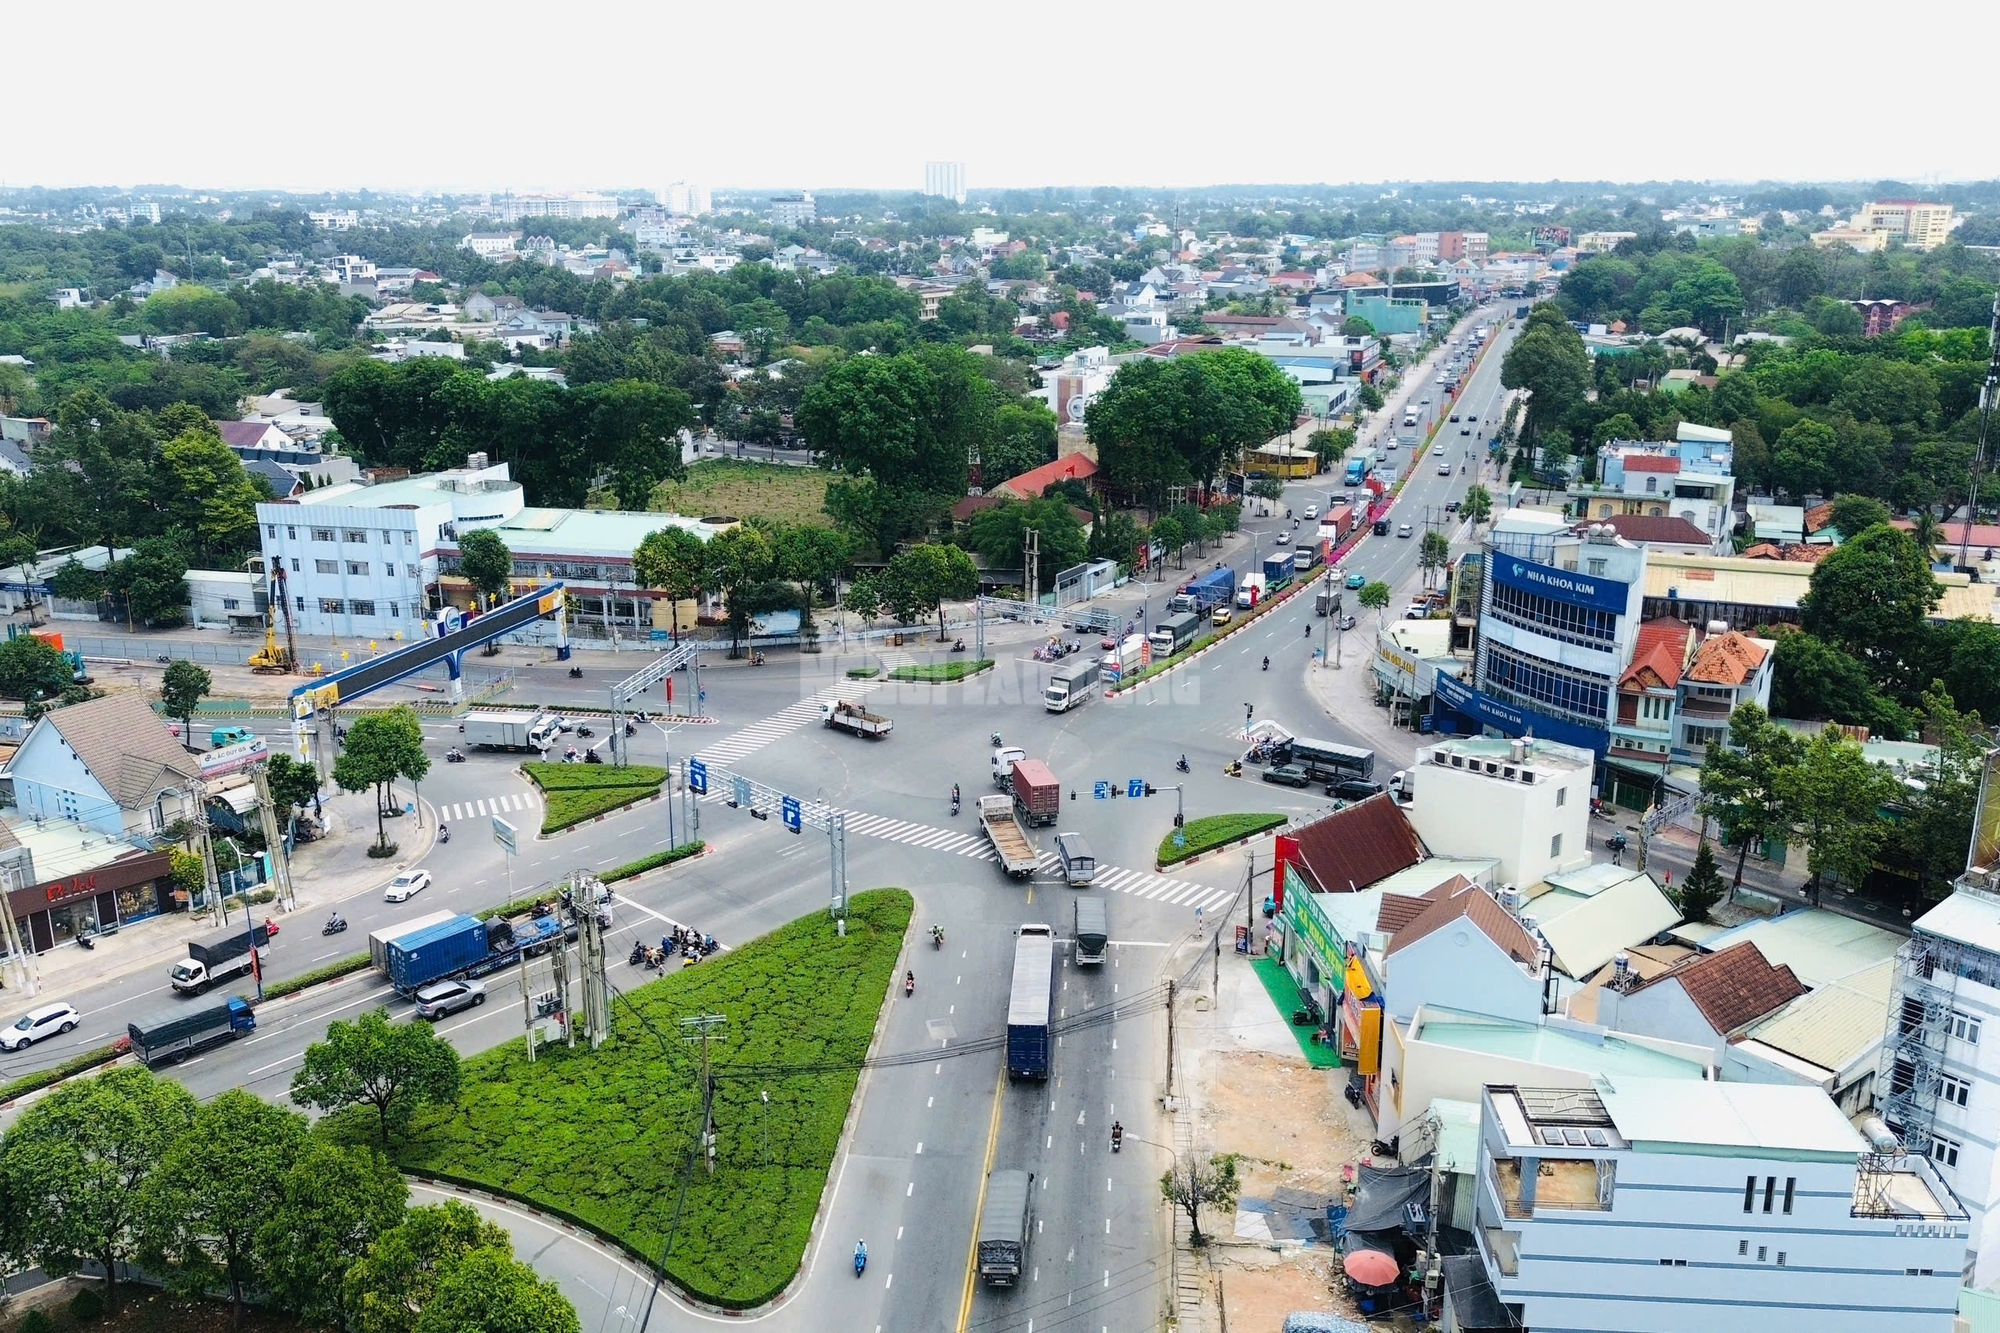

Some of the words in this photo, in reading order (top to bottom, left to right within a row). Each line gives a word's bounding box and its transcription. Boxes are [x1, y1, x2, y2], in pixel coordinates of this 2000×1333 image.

[1527, 570, 1546, 583] NHA
[1547, 575, 1574, 591] KHOA
[1575, 583, 1595, 596] KIM
[1479, 702, 1491, 713] NHA
[1491, 706, 1508, 720] KHOA
[1508, 714, 1522, 724] KIM
